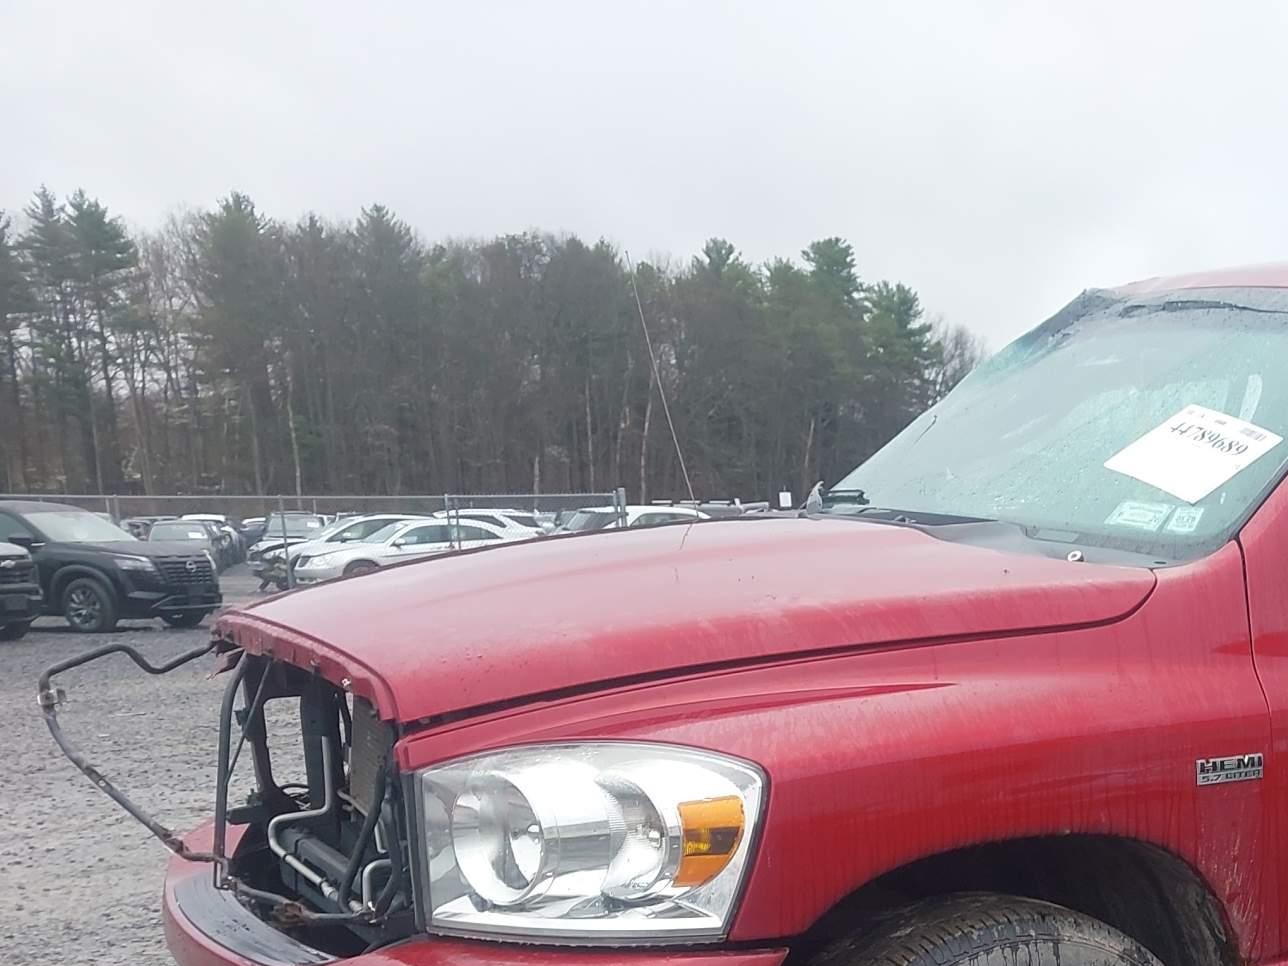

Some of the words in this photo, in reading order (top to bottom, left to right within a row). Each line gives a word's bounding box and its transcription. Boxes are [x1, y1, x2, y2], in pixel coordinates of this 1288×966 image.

[1169, 421, 1249, 456] 44789689
[1199, 755, 1263, 773] HEMI
[1201, 774, 1222, 783] 5.7
[1225, 769, 1260, 780] LITER
